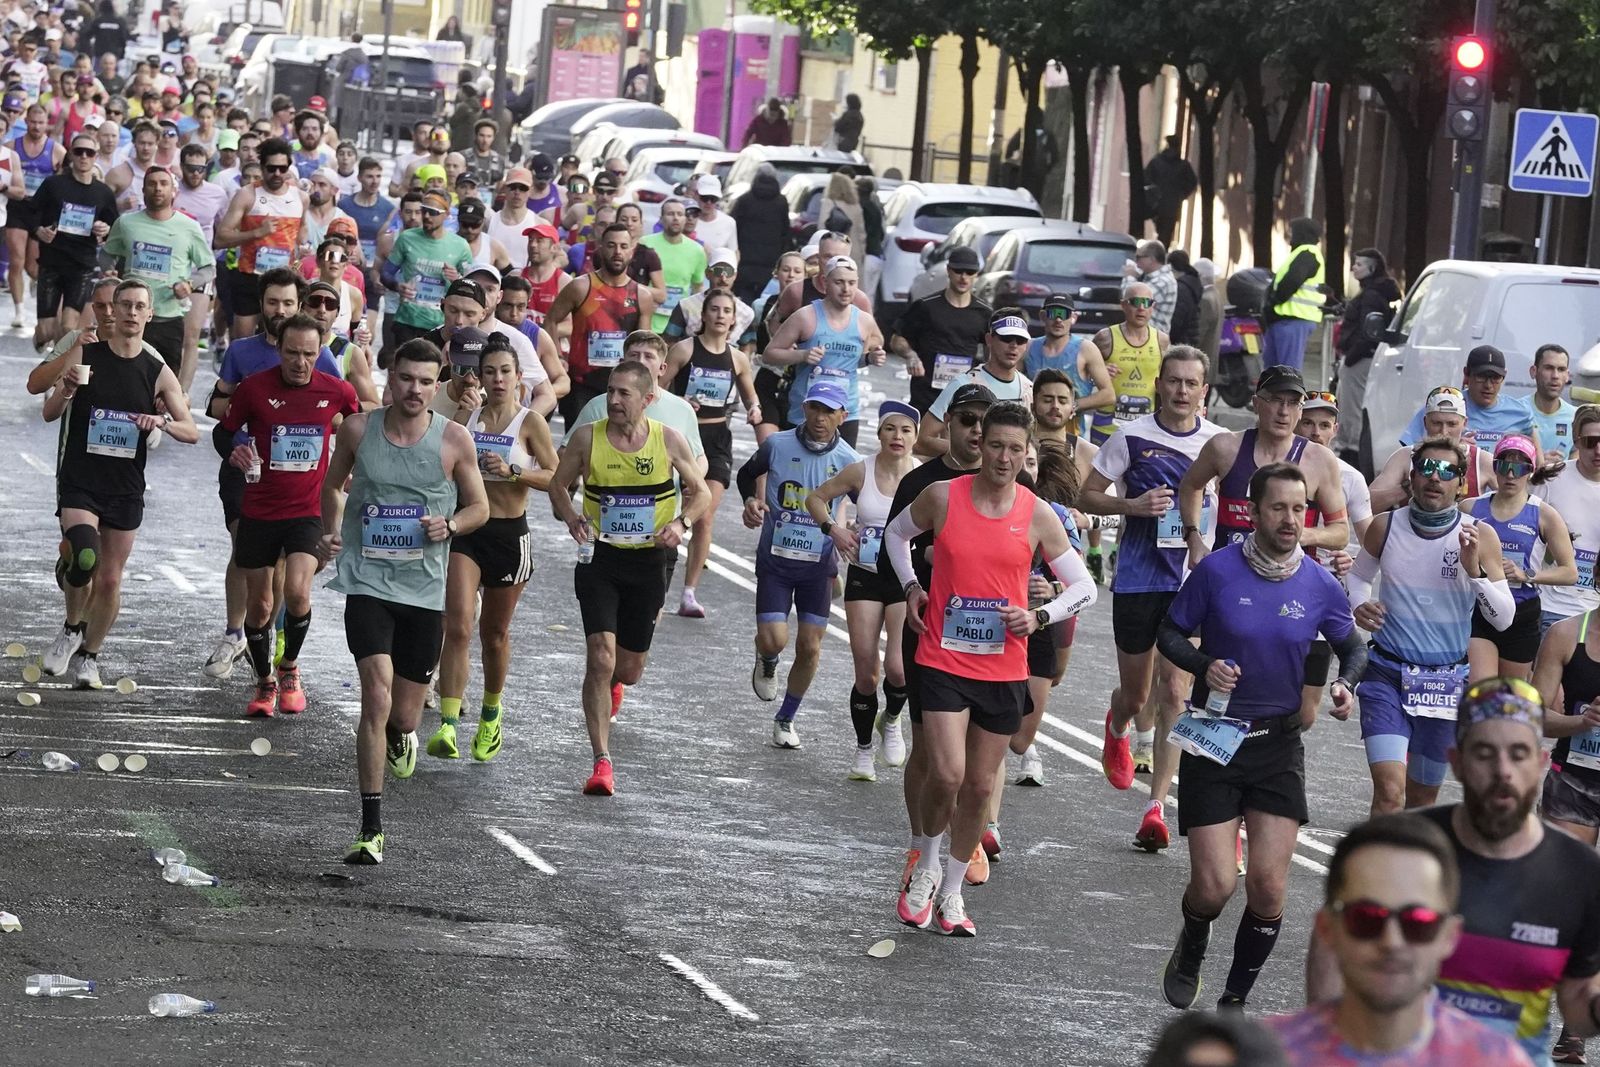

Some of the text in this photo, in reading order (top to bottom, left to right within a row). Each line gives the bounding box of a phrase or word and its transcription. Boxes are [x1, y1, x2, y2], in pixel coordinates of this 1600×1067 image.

[137, 261, 162, 271] JULIEN
[594, 350, 621, 358] JULIETA
[107, 412, 130, 420] ZURIC
[289, 427, 319, 435] ZURICH
[99, 434, 128, 446] KEVIN
[478, 434, 508, 444] ZURICH
[285, 450, 310, 460] YAYO
[382, 508, 417, 516] ZURICH
[620, 512, 636, 520] 8497
[383, 524, 402, 532] 9376
[611, 521, 644, 533] SALAS
[1171, 525, 1184, 536] PI
[791, 529, 807, 538] 7945
[371, 534, 413, 547] MAXOU
[782, 536, 813, 551] MARCI
[1500, 542, 1519, 550] RICH
[1441, 566, 1459, 577] OTSO
[1576, 575, 1595, 588] CZA
[966, 600, 1002, 608] ZURICH
[965, 616, 985, 625] 6784
[956, 626, 994, 641] PABLO
[1423, 682, 1446, 691] 16042
[1407, 692, 1457, 707] PAQUETE
[1173, 723, 1232, 763] JEAN-BAPTISTE
